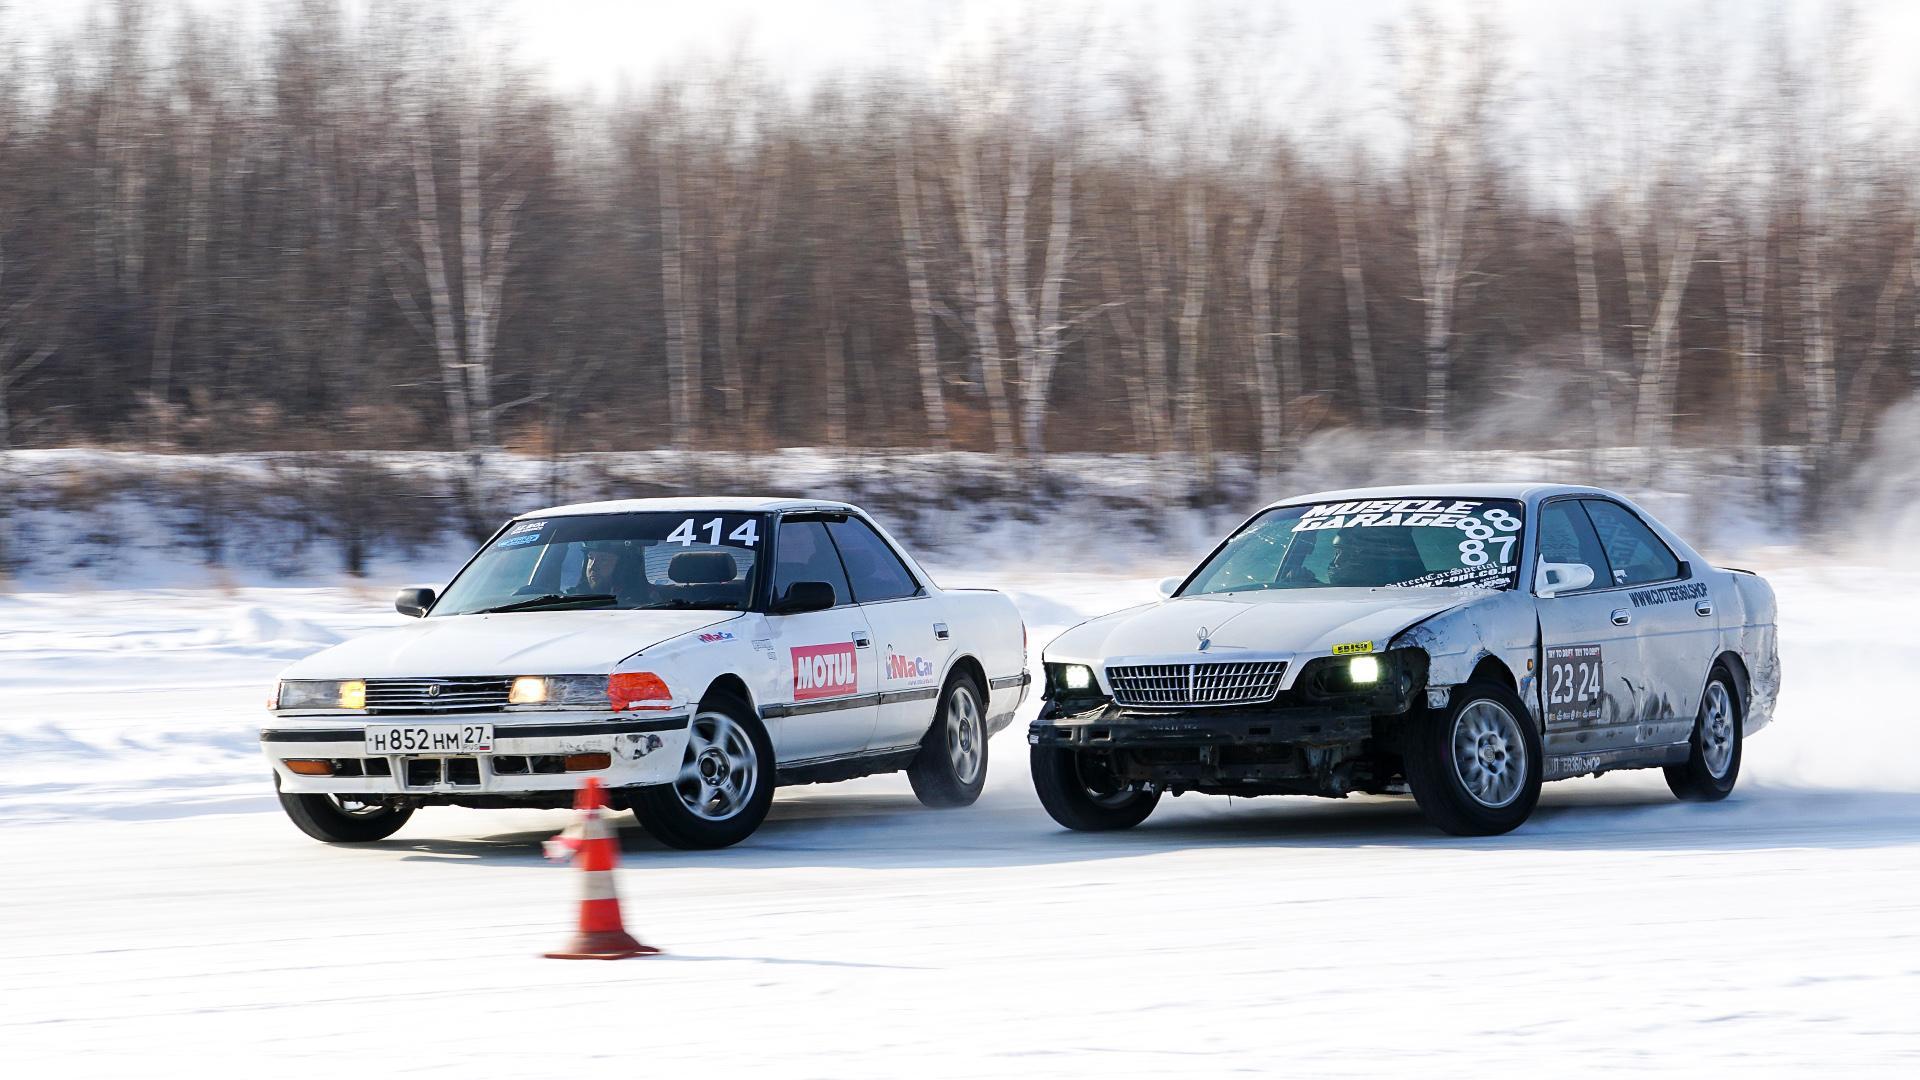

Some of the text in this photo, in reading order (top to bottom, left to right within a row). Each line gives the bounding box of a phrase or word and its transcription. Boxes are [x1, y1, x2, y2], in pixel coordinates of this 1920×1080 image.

[1291, 513, 1467, 532] GARAGE
[1300, 500, 1483, 519] MUSCLE
[666, 518, 760, 546] 414
[1458, 536, 1517, 566] 87
[1629, 583, 1708, 607] WWW.CUTTER360.SHOP
[797, 652, 856, 690] MOTUL
[1551, 664, 1574, 704] 23
[1578, 662, 1601, 702] 24
[464, 727, 484, 743] 27
